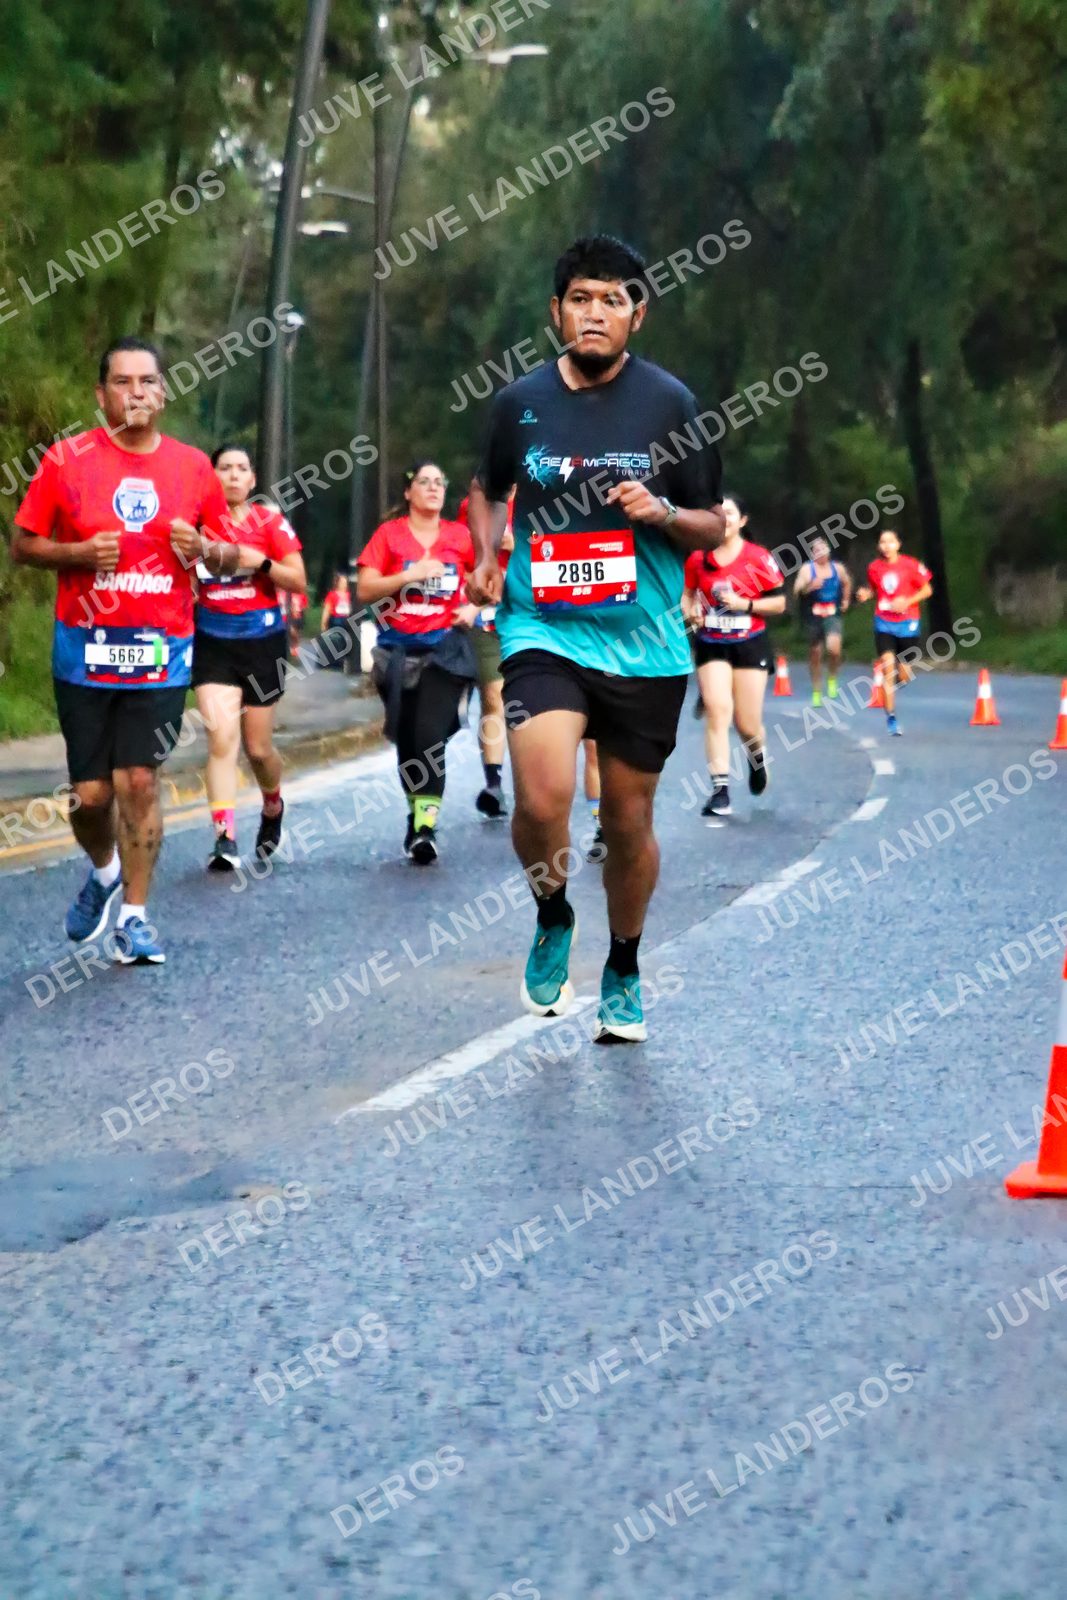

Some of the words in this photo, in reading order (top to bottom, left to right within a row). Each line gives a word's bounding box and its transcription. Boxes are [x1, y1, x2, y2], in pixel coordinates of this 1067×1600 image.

[93, 571, 174, 594] SANTIAGO
[558, 561, 605, 584] 2896
[109, 648, 145, 664] 5662
